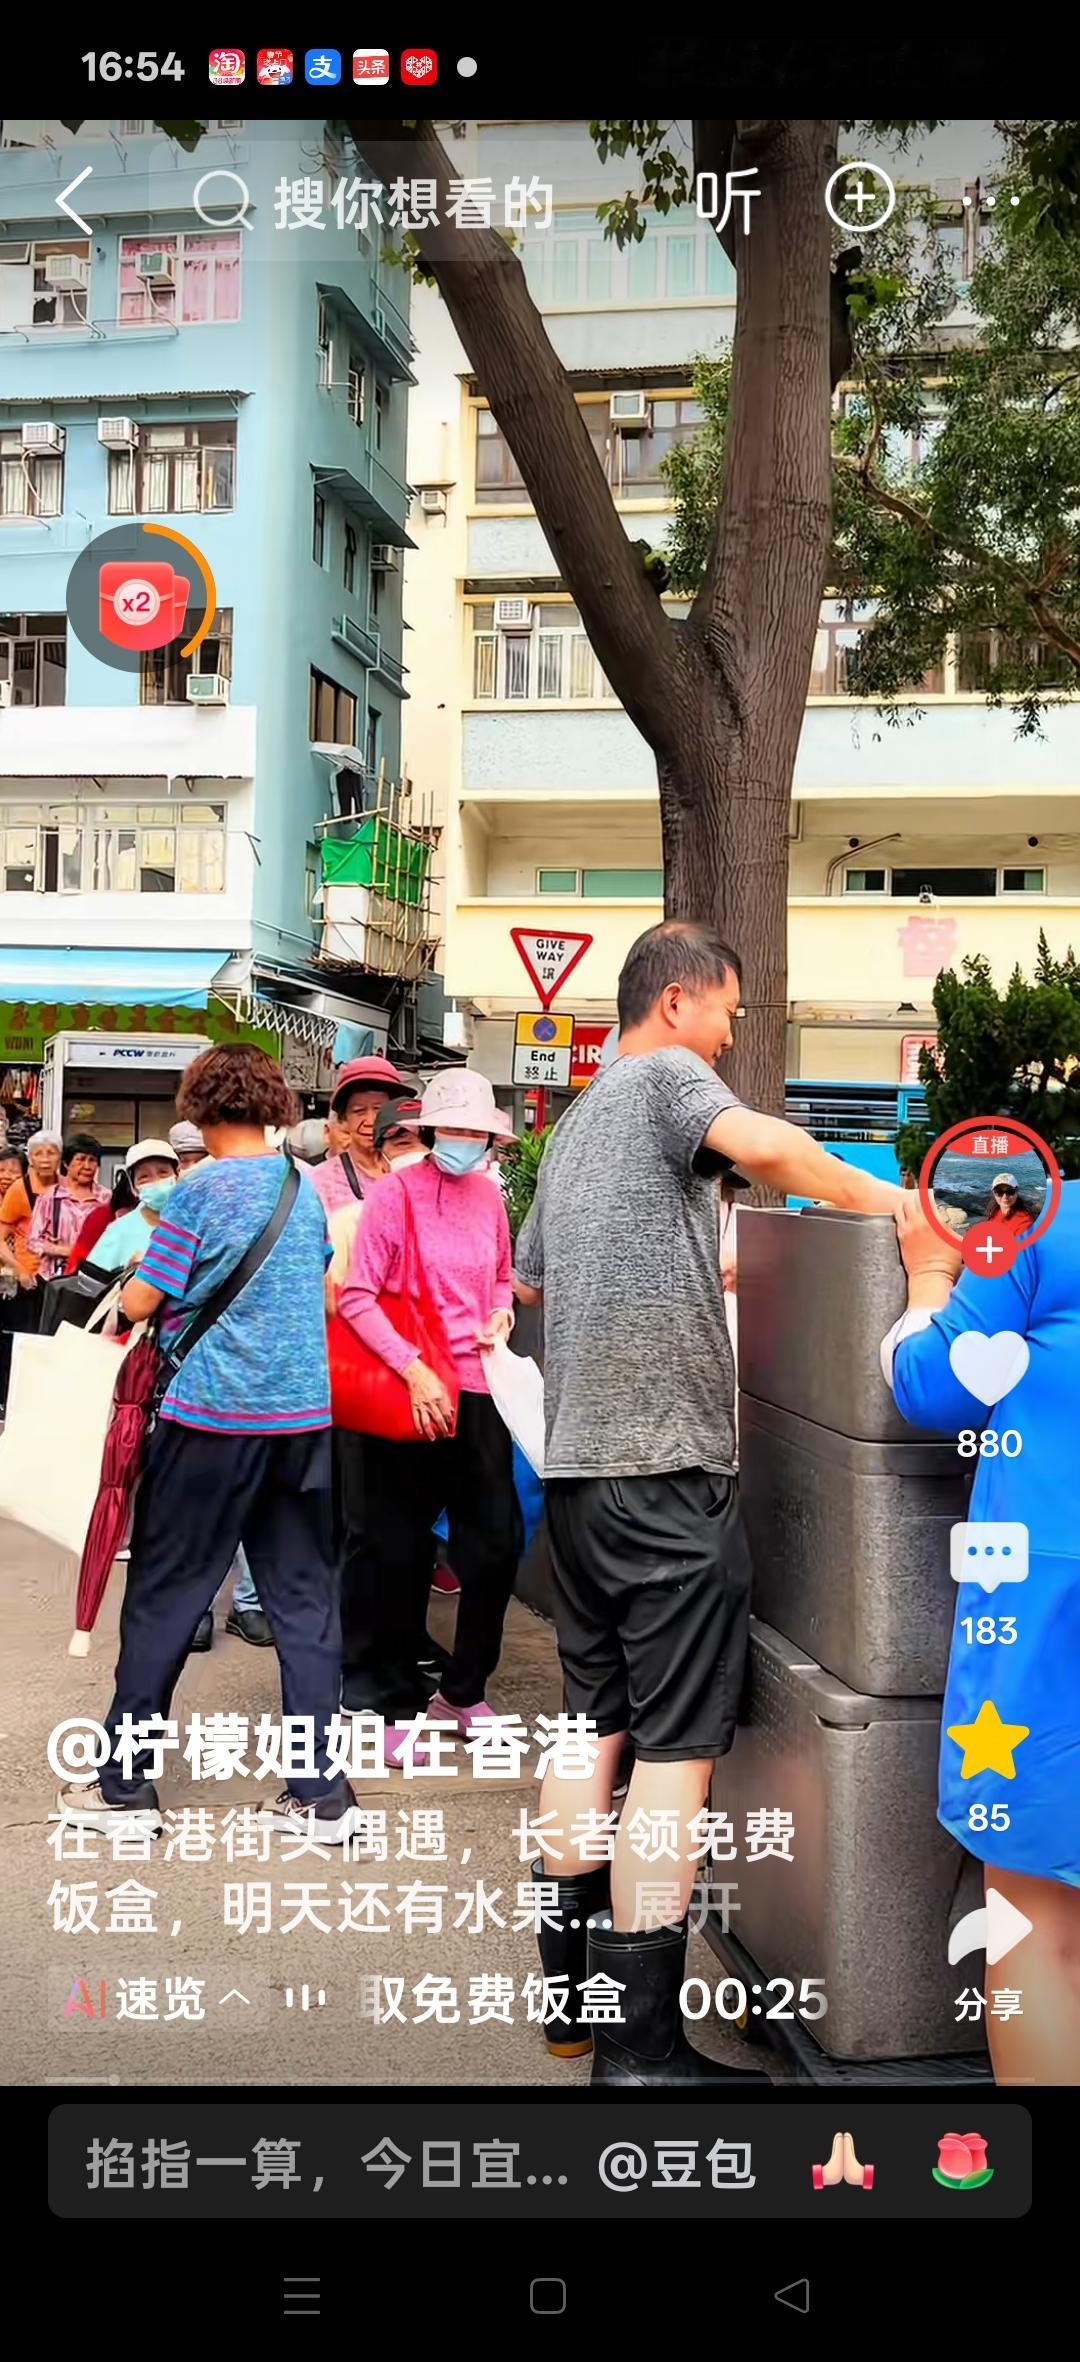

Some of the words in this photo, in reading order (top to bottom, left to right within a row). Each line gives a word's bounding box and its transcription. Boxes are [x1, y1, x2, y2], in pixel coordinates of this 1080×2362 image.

[536, 938, 566, 951] GIVE
[536, 950, 564, 962] WAY
[113, 1049, 145, 1057] PCCW
[530, 1050, 556, 1062] End
